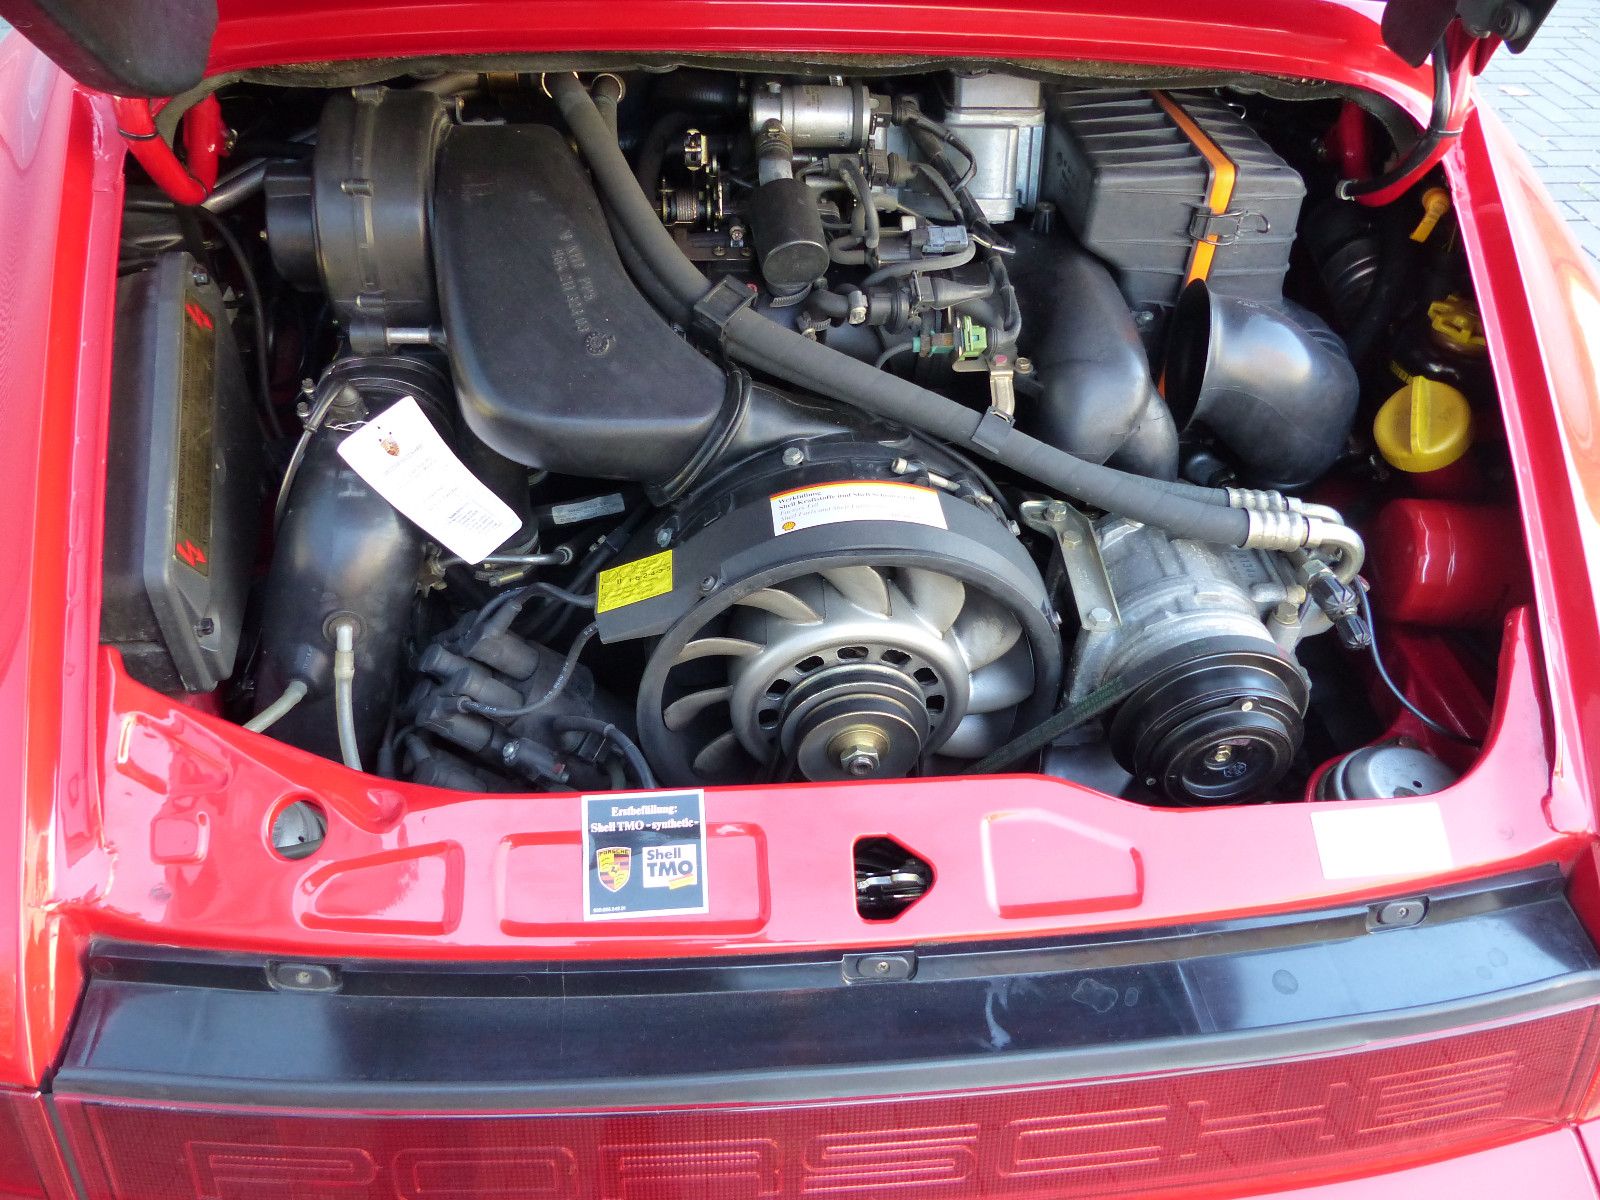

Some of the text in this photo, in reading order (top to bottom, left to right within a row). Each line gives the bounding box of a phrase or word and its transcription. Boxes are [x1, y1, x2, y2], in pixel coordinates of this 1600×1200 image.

[590, 822, 616, 833] Shell
[616, 820, 644, 831] TMO
[647, 847, 682, 860] Shell
[647, 860, 694, 877] TMO
[183, 1051, 1518, 1200] PORSCHE
